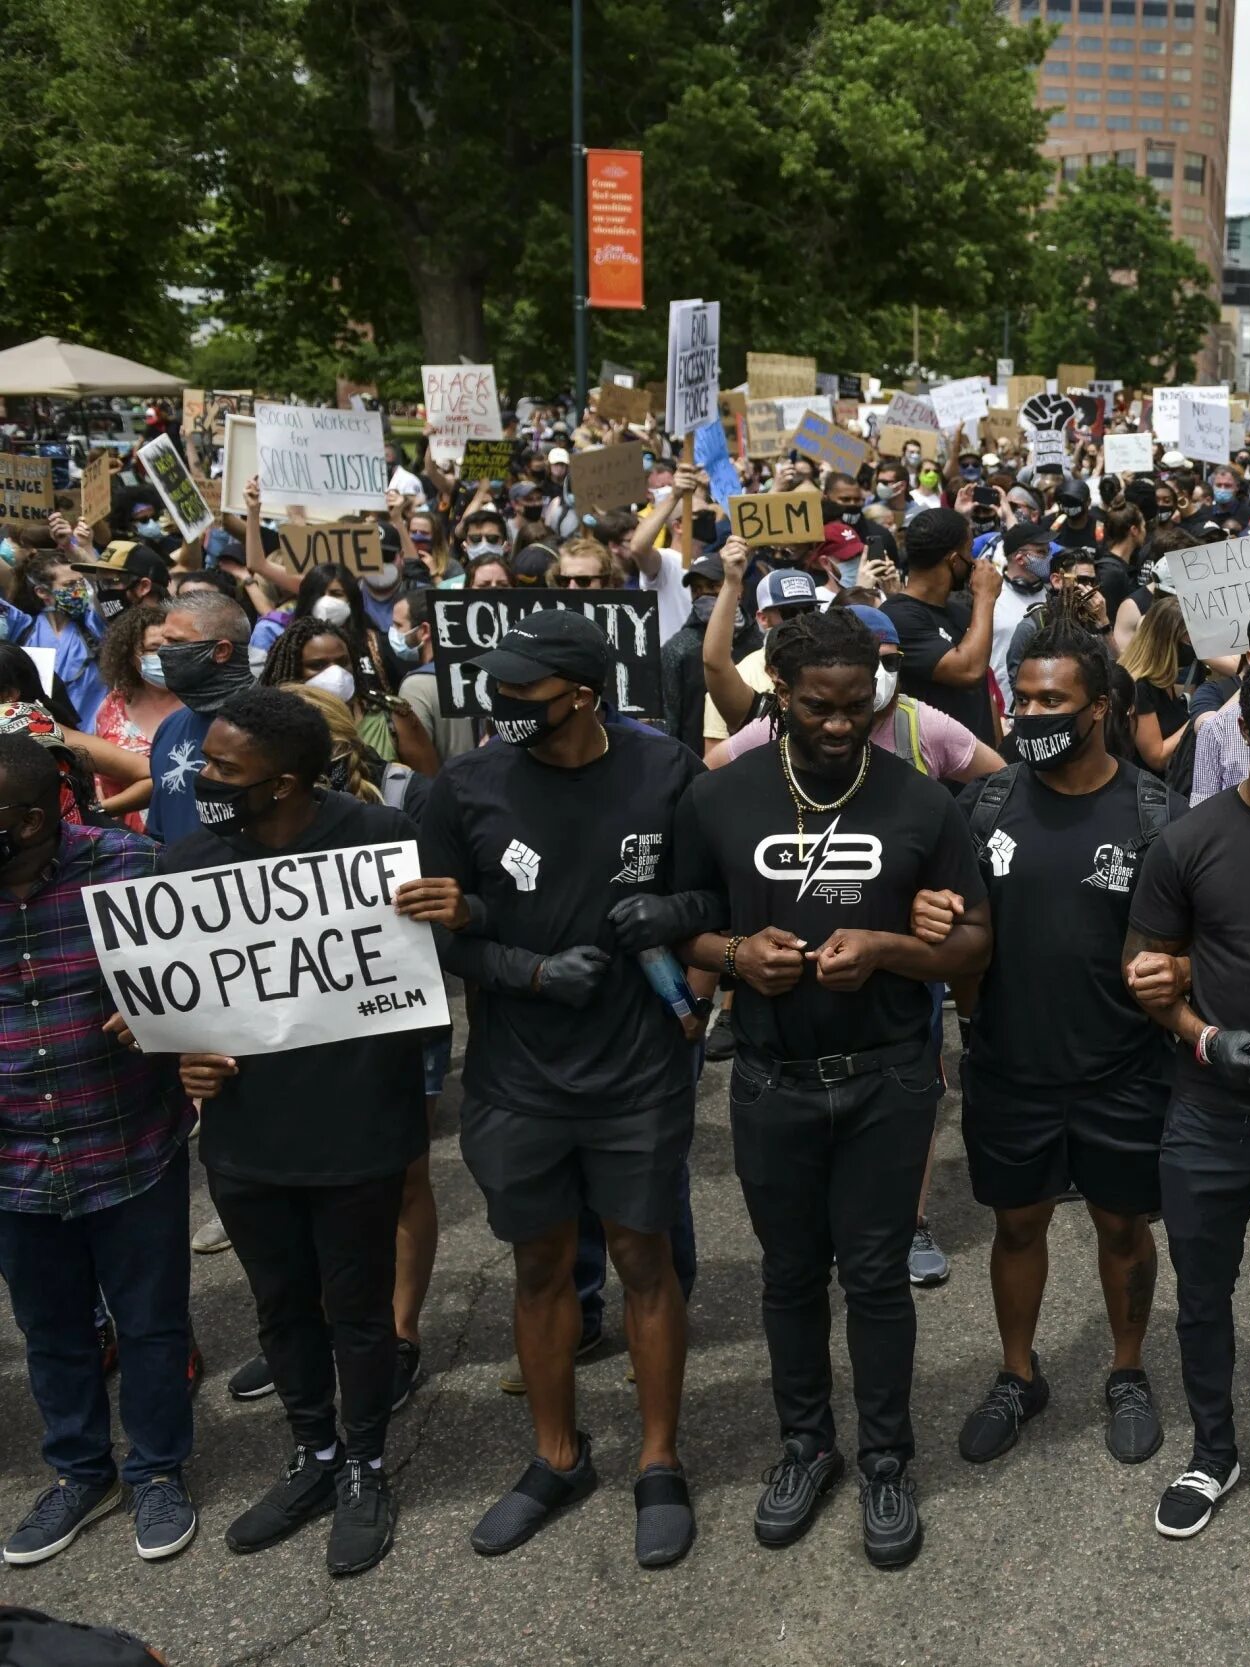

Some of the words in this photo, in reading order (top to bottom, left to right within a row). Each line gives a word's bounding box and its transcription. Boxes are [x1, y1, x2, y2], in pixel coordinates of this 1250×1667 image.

[691, 313, 708, 347] END
[678, 348, 716, 391] EXCESSIVE
[428, 372, 491, 396] BLACK
[430, 394, 488, 416] LIVES
[684, 384, 708, 424] FORCE
[259, 405, 304, 429] Social
[312, 411, 371, 433] Workers
[291, 432, 310, 447] for
[260, 447, 317, 490] SOCIAL
[320, 453, 387, 493] JUSTICE
[737, 501, 811, 539] BLM
[281, 528, 380, 573] VOTE
[1031, 731, 1073, 762] BREATHE
[638, 845, 651, 856] FOR
[639, 833, 663, 846] JUSTICE
[637, 854, 661, 866] GEORGE
[637, 865, 655, 877] FLOYD
[1110, 864, 1135, 878] GEORGE
[1111, 854, 1123, 866] FOR
[812, 882, 862, 905] 45
[1108, 874, 1129, 887] FLOYD
[93, 881, 184, 952] NO
[191, 846, 404, 934] JUSTICE
[113, 960, 202, 1017] NO
[209, 924, 398, 1008] PEACE
[357, 988, 427, 1017] #BLM
